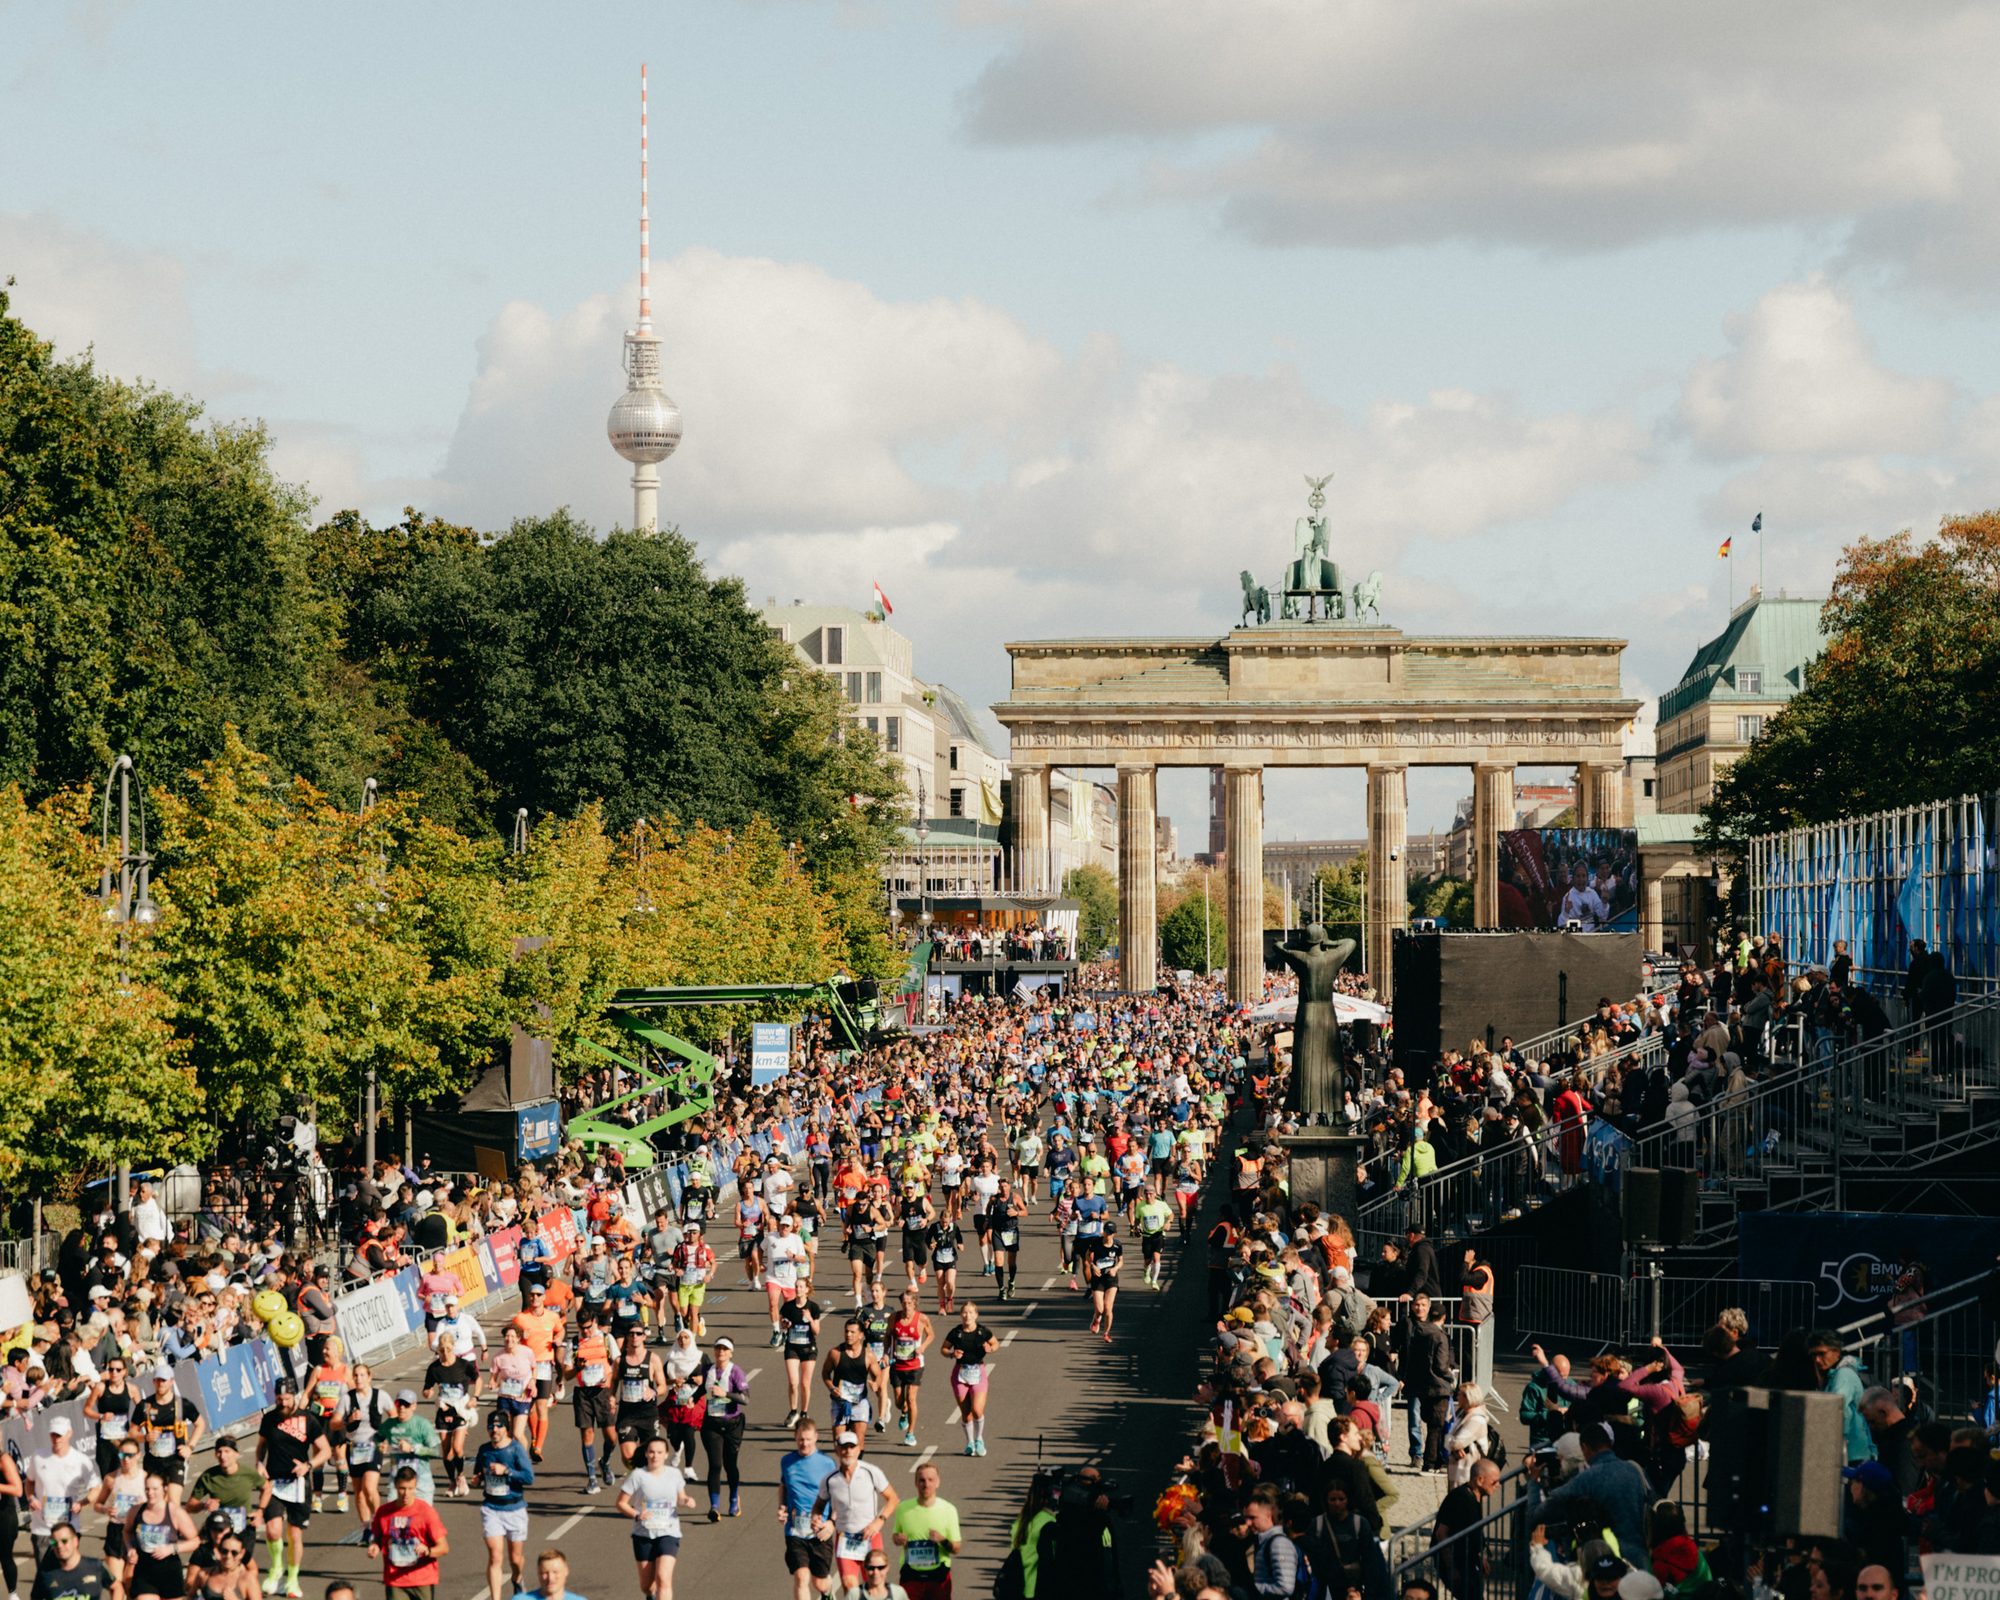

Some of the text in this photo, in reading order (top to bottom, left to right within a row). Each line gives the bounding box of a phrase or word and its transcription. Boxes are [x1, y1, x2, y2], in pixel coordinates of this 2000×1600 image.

[755, 1055, 787, 1066] km 42
[1871, 1263, 1903, 1275] BMW
[1933, 1564, 2000, 1585] I'M PRO
[1933, 1586, 1958, 1600] OF
